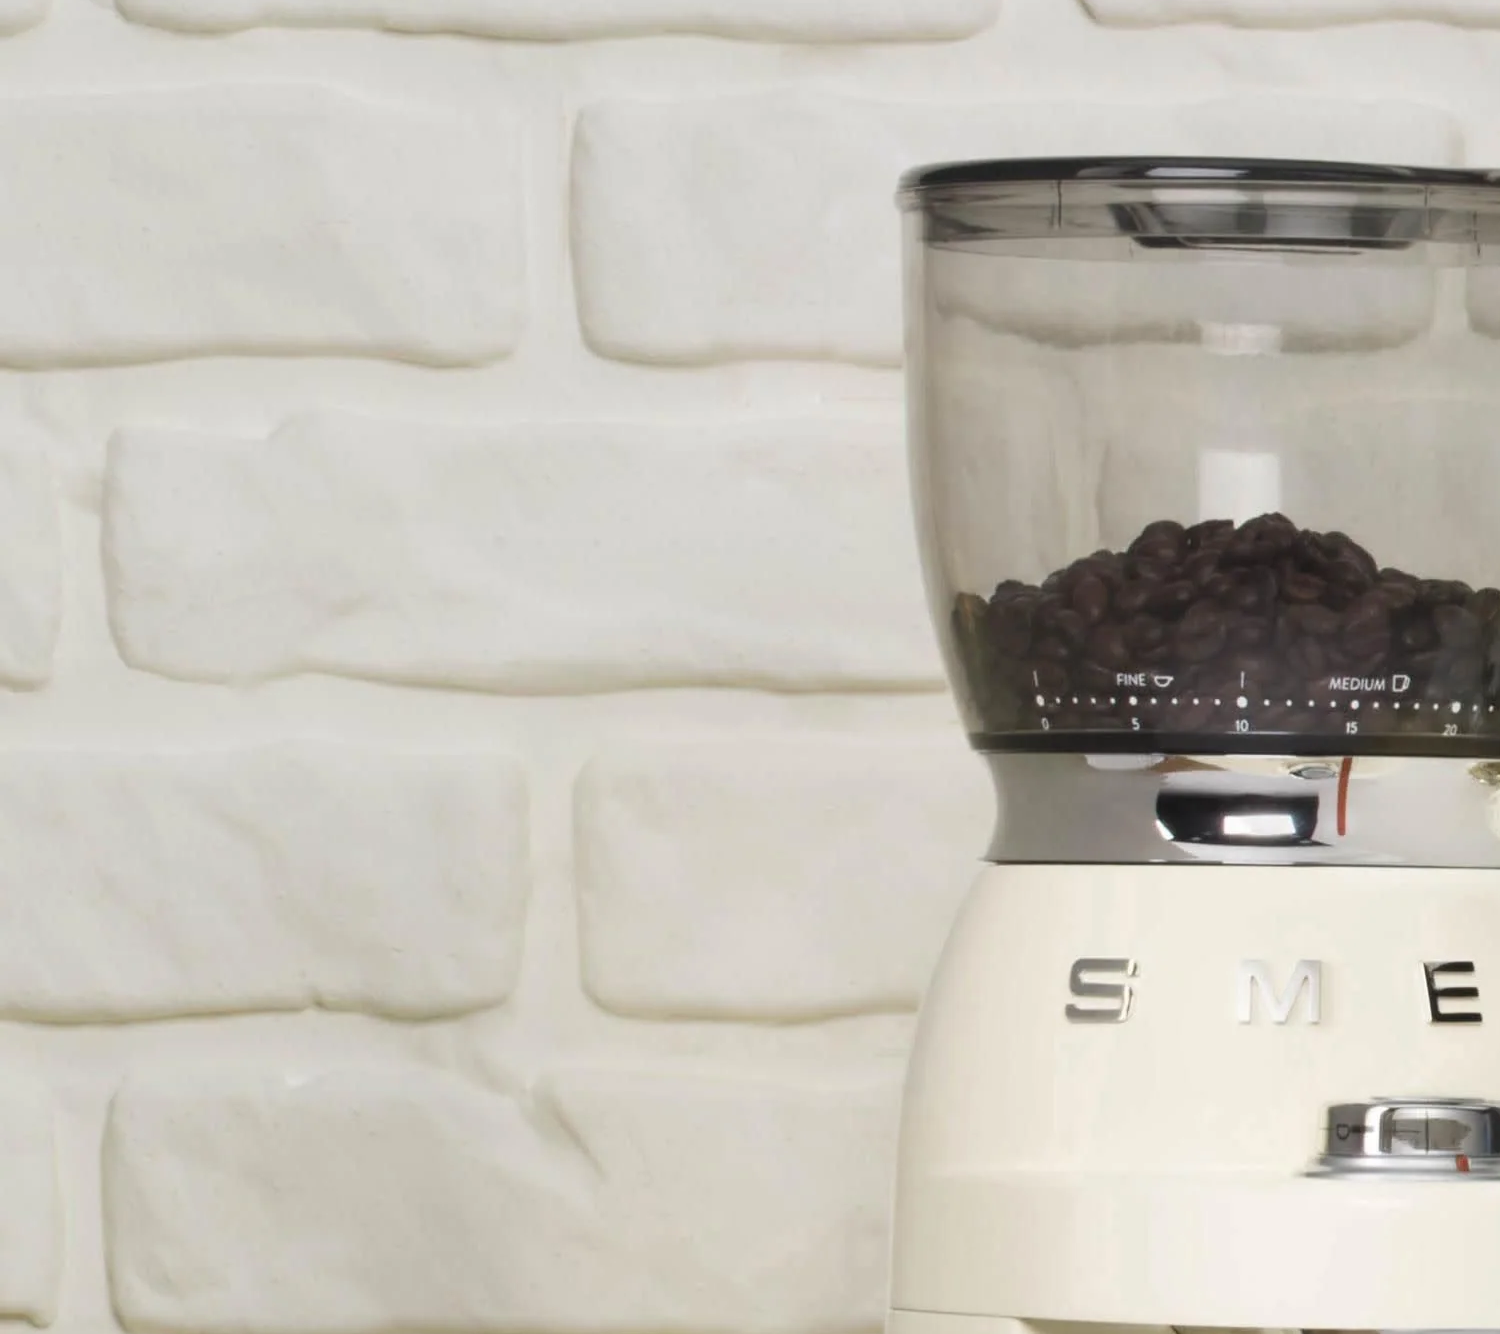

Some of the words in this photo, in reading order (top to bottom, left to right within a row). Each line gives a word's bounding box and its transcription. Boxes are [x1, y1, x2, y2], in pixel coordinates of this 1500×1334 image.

[1116, 673, 1146, 687] FINE
[1328, 677, 1386, 691] MEDIUM
[1041, 717, 1050, 730] 0
[1131, 717, 1140, 731] 5
[1235, 719, 1249, 732] 10
[1345, 721, 1358, 734] 15
[1442, 724, 1458, 736] 20
